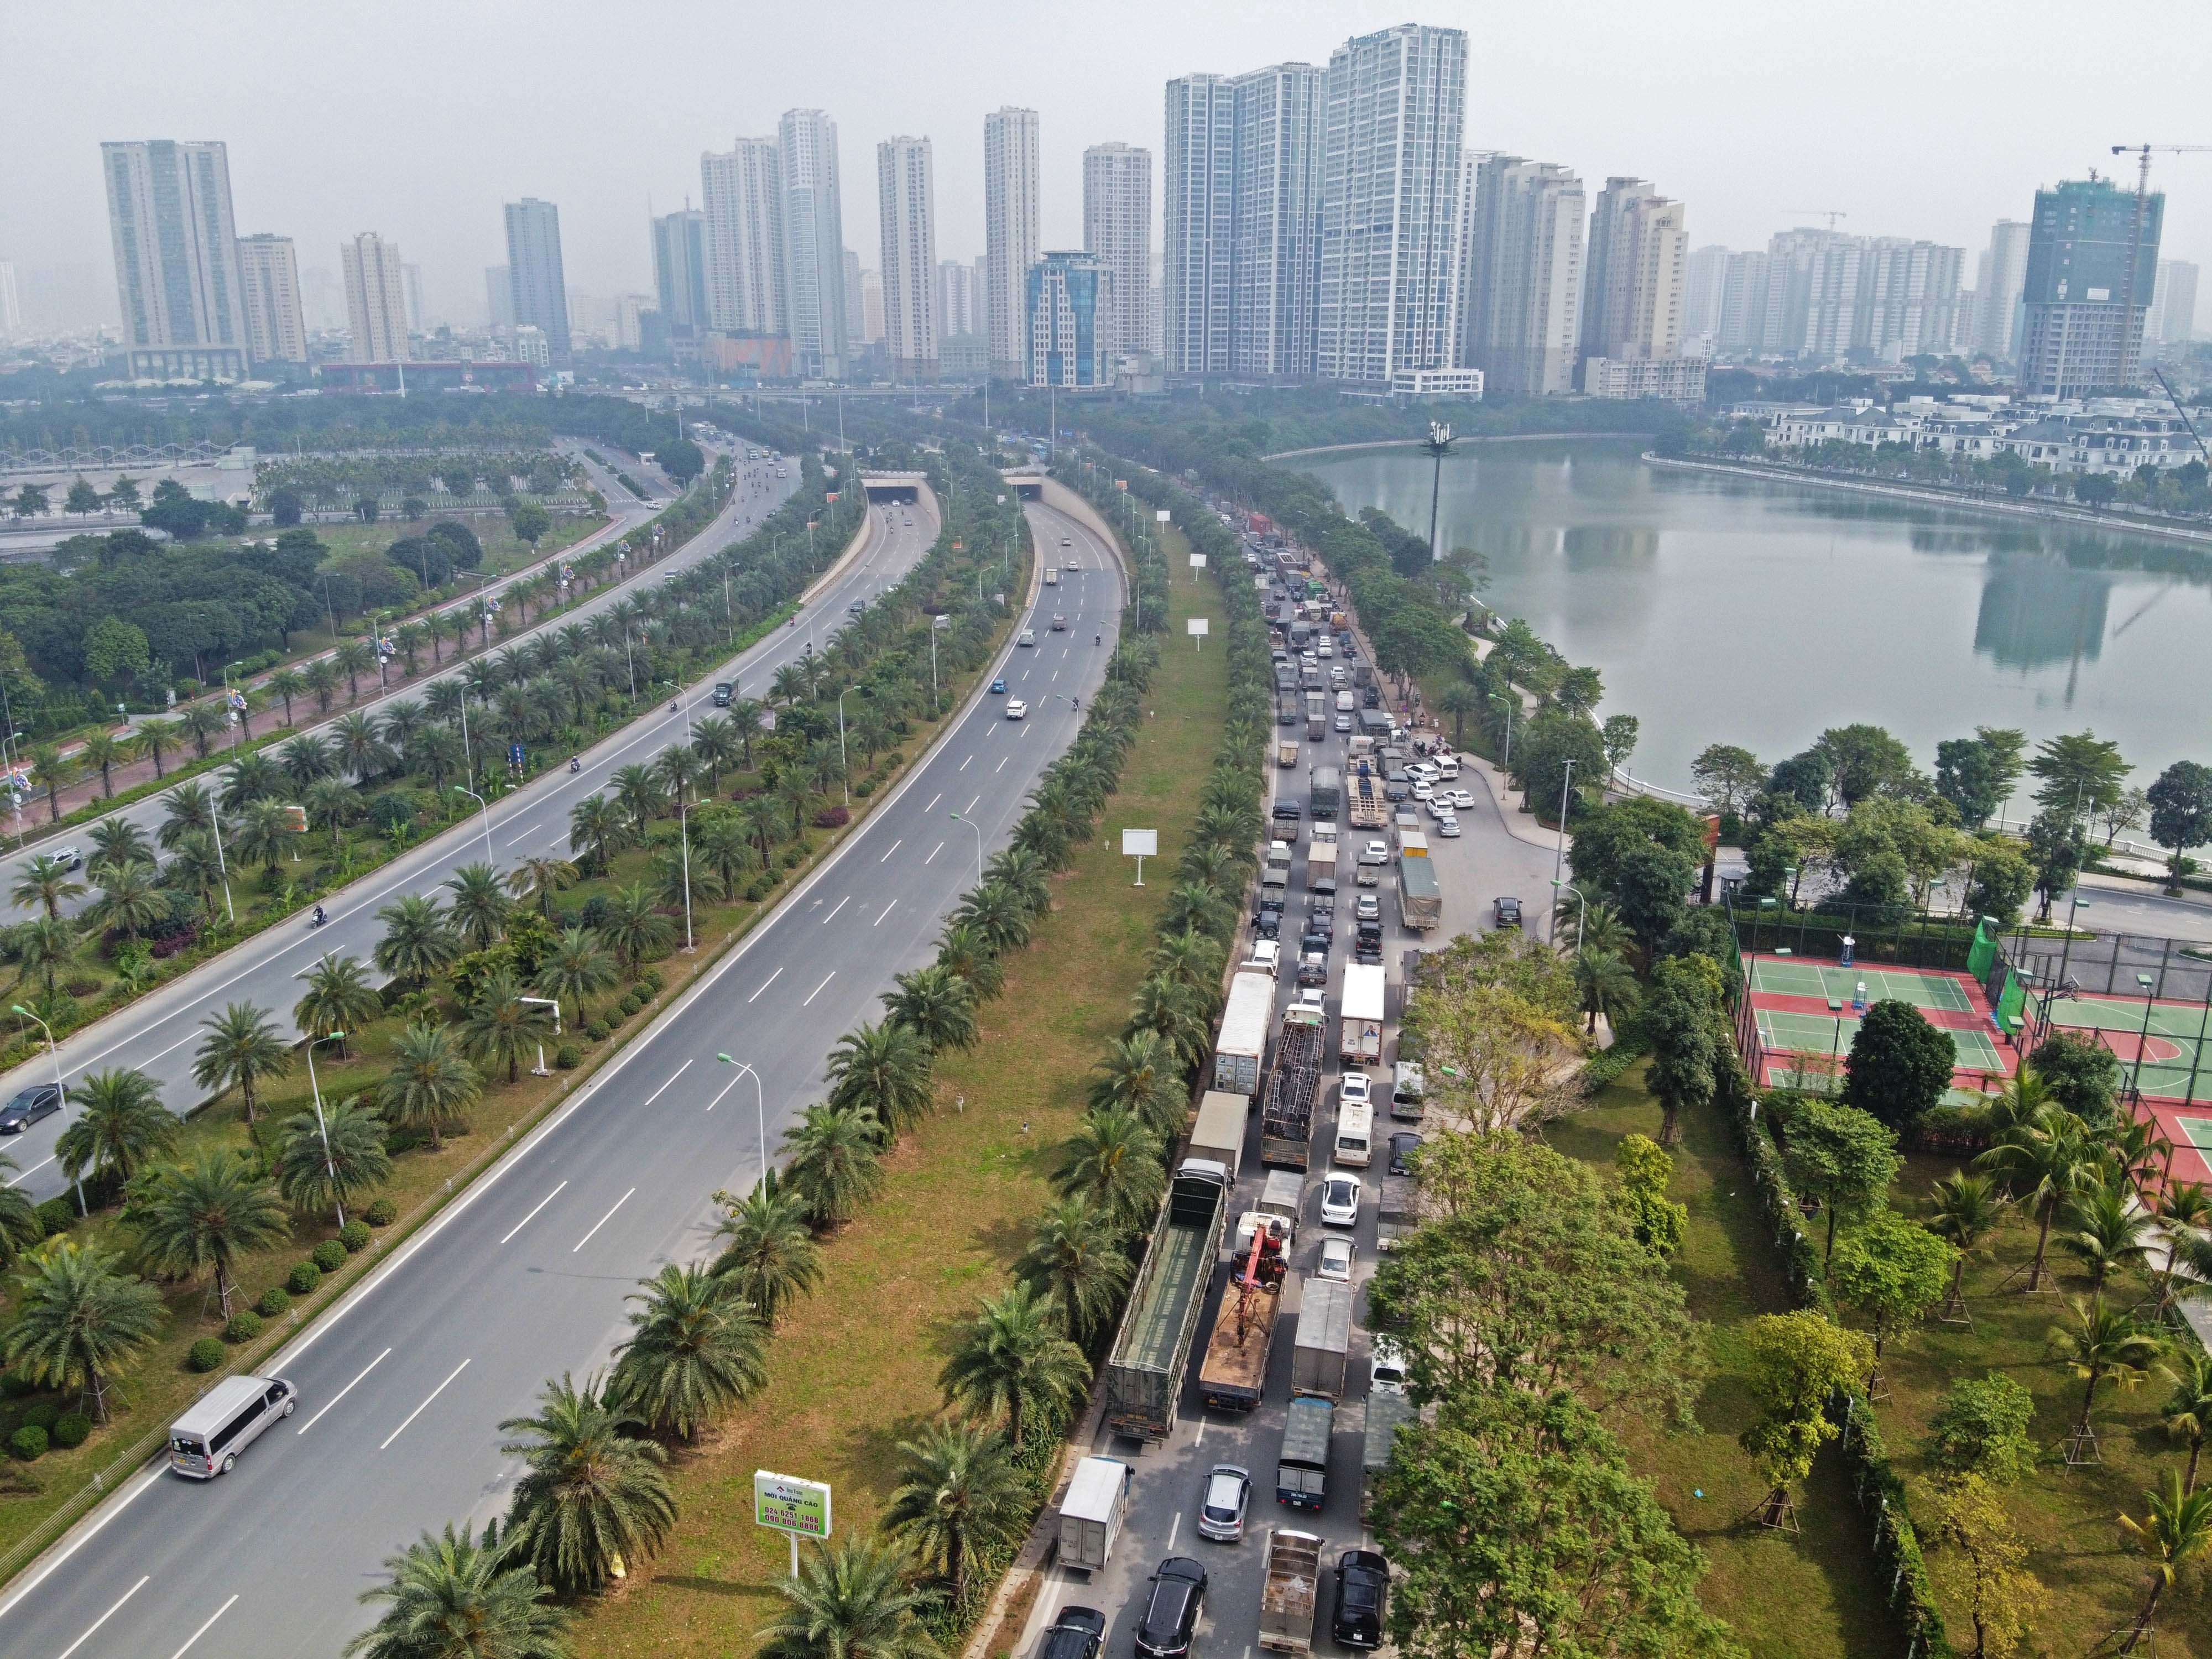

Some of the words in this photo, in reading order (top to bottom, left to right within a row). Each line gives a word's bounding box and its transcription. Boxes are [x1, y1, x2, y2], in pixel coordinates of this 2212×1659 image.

[779, 1495, 802, 1504] QUẢNG
[765, 1506, 778, 1515] 024
[780, 1510, 797, 1519] 6251
[801, 1515, 818, 1524] 1868
[765, 1515, 779, 1523] 090
[782, 1518, 796, 1527] 806
[799, 1522, 818, 1531] 8888
